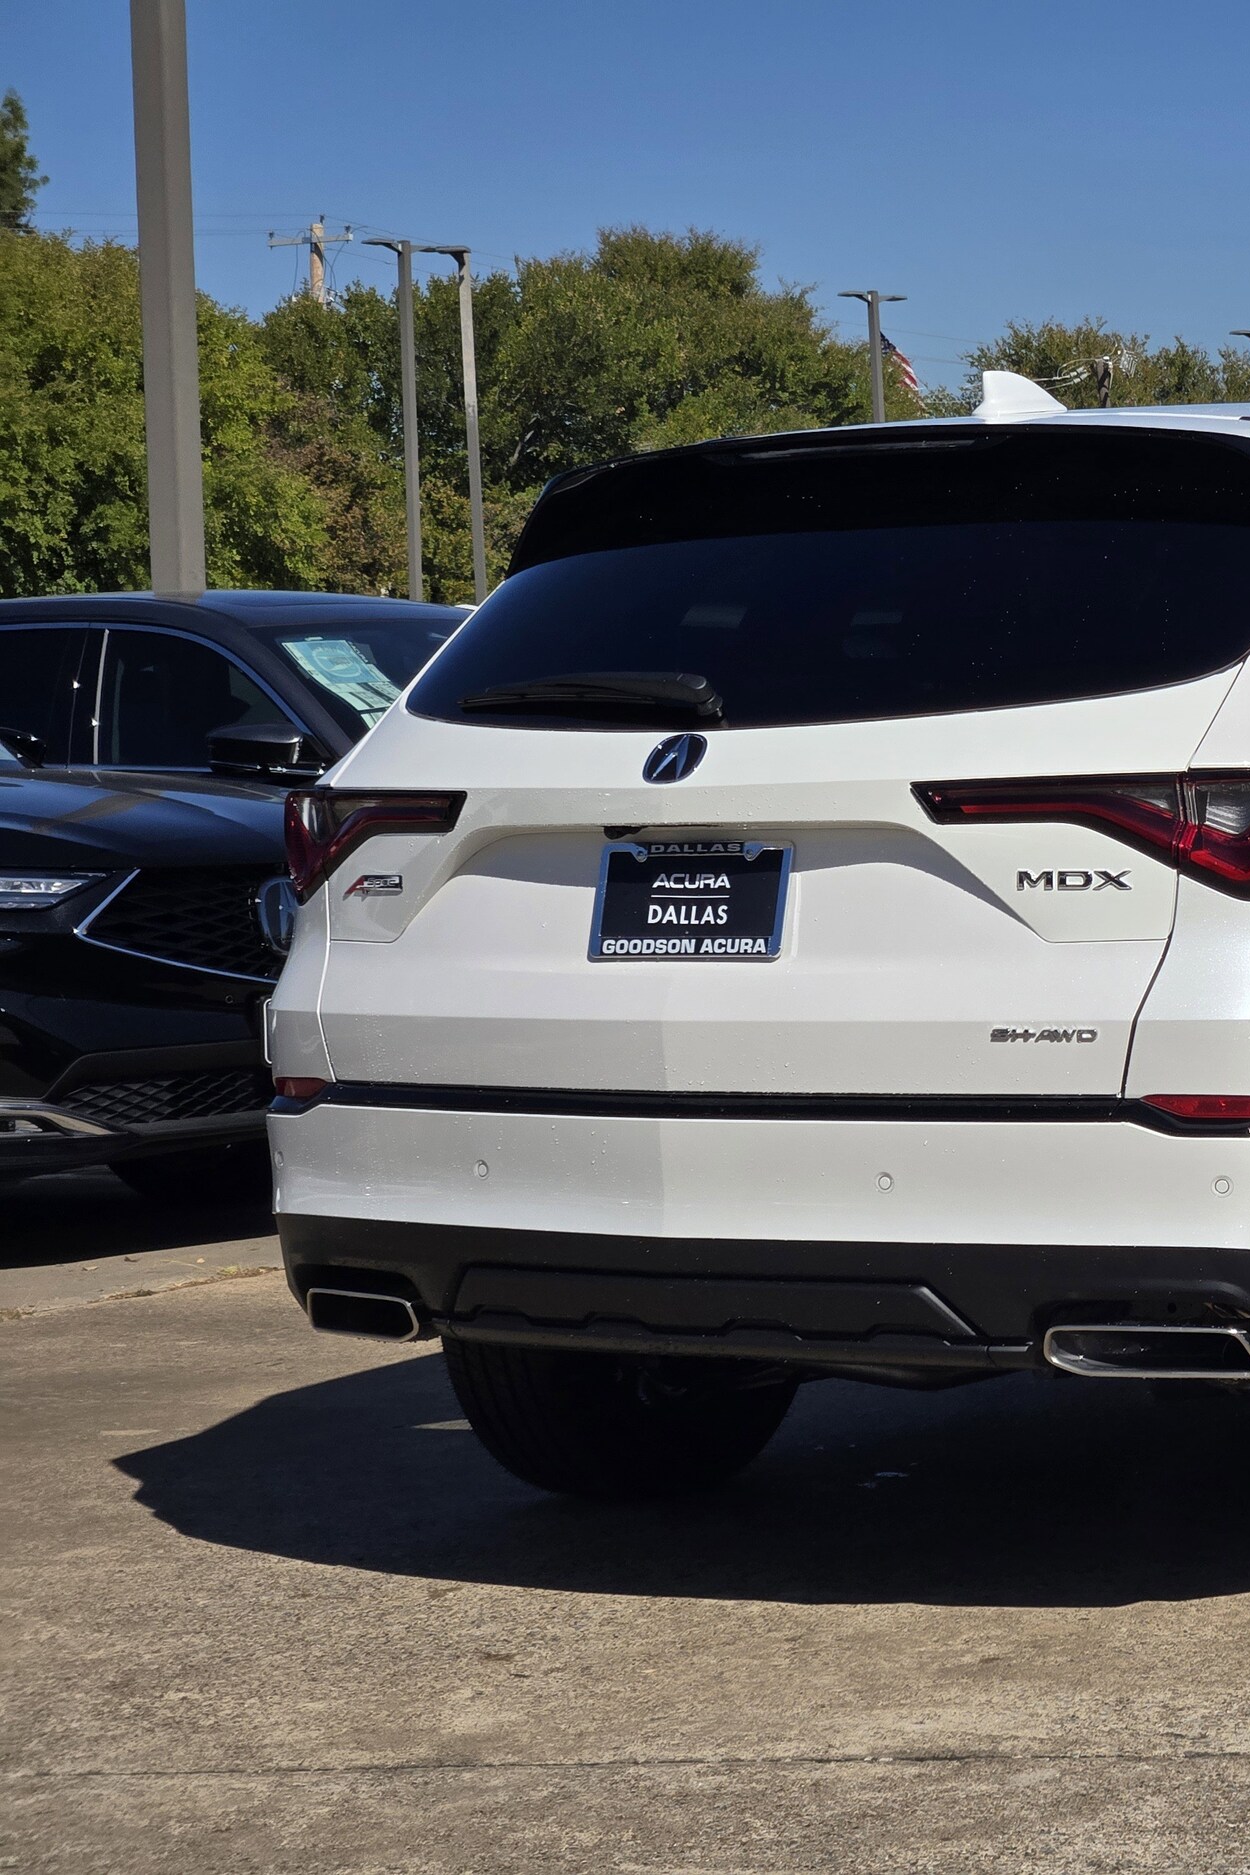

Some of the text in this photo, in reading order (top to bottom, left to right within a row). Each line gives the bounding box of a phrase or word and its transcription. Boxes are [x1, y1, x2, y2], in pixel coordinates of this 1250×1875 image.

[650, 843, 741, 854] DALLAS
[652, 873, 731, 889] ACURA
[1016, 870, 1133, 892] MDX
[647, 904, 729, 926] DALLAS
[602, 938, 767, 955] GOODSON ACURA
